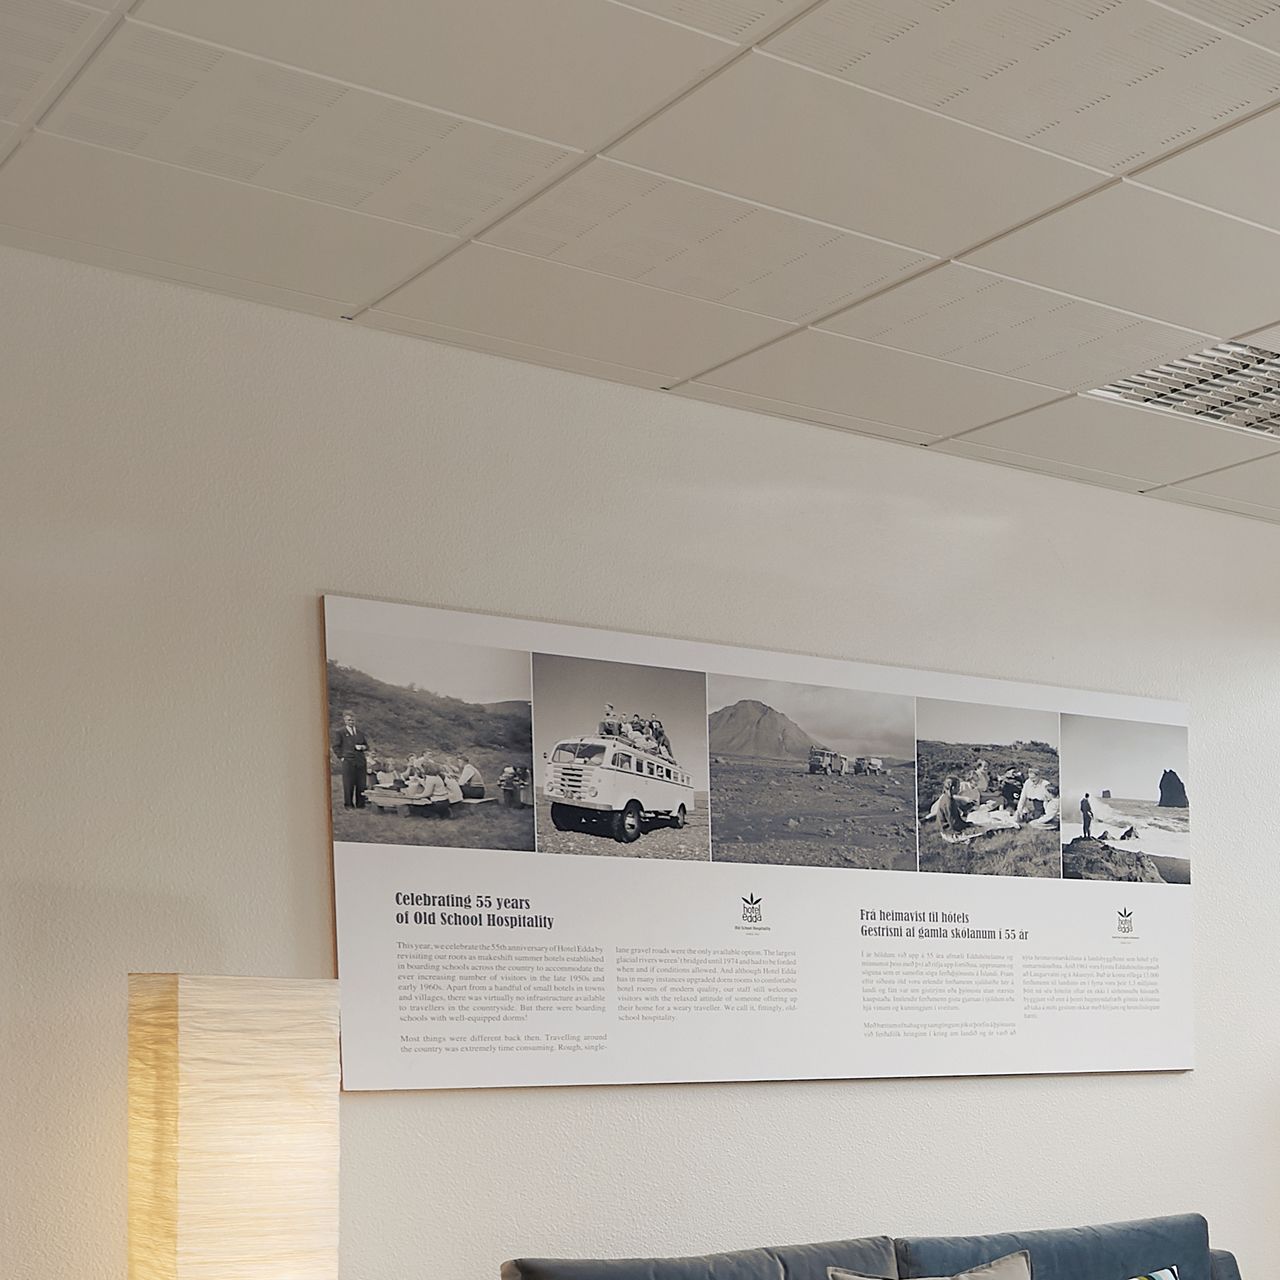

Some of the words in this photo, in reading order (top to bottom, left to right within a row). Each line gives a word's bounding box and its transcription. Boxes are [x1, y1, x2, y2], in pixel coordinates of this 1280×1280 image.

[396, 892, 472, 910] Celebrating
[476, 896, 492, 908] 55
[497, 898, 530, 910] years
[743, 904, 760, 914] hotel
[860, 909, 876, 921] Frá
[879, 910, 926, 922] heimavist
[928, 911, 938, 923] til
[941, 912, 969, 924] hótels
[396, 911, 409, 924] of
[414, 911, 436, 925] Old
[441, 912, 482, 926] School
[487, 914, 554, 929] Hospitality
[742, 914, 762, 922] edda
[861, 925, 902, 937] Gestrisni
[918, 928, 948, 938] gamla
[951, 928, 996, 939] skólanum
[1005, 929, 1016, 940] 55
[1019, 929, 1028, 940] ár
